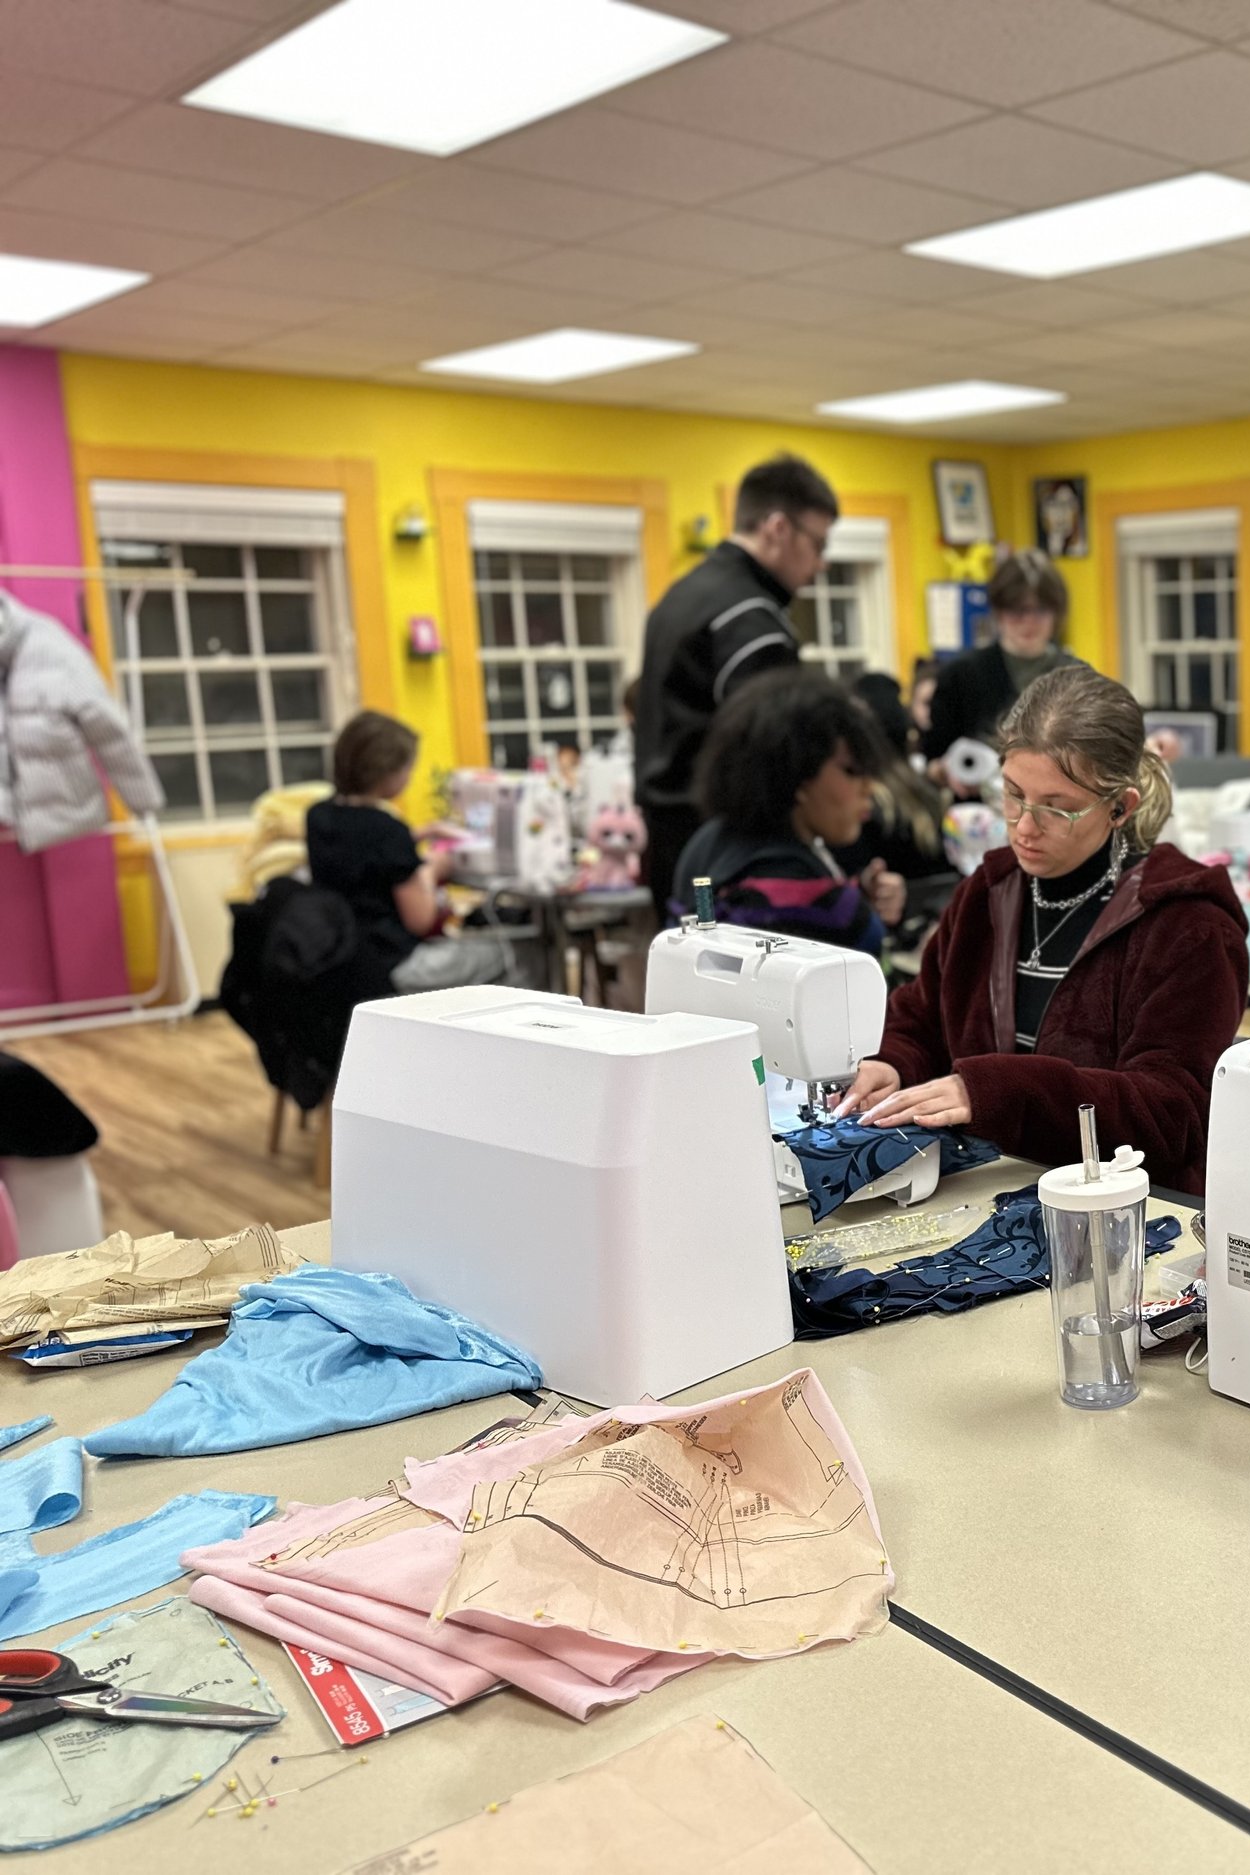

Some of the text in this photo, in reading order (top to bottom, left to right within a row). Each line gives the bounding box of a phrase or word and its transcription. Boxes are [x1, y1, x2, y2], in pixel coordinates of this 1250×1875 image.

[81, 1651, 136, 1678] licity
[177, 1681, 208, 1698] CKET
[343, 1711, 371, 1736] 8545
